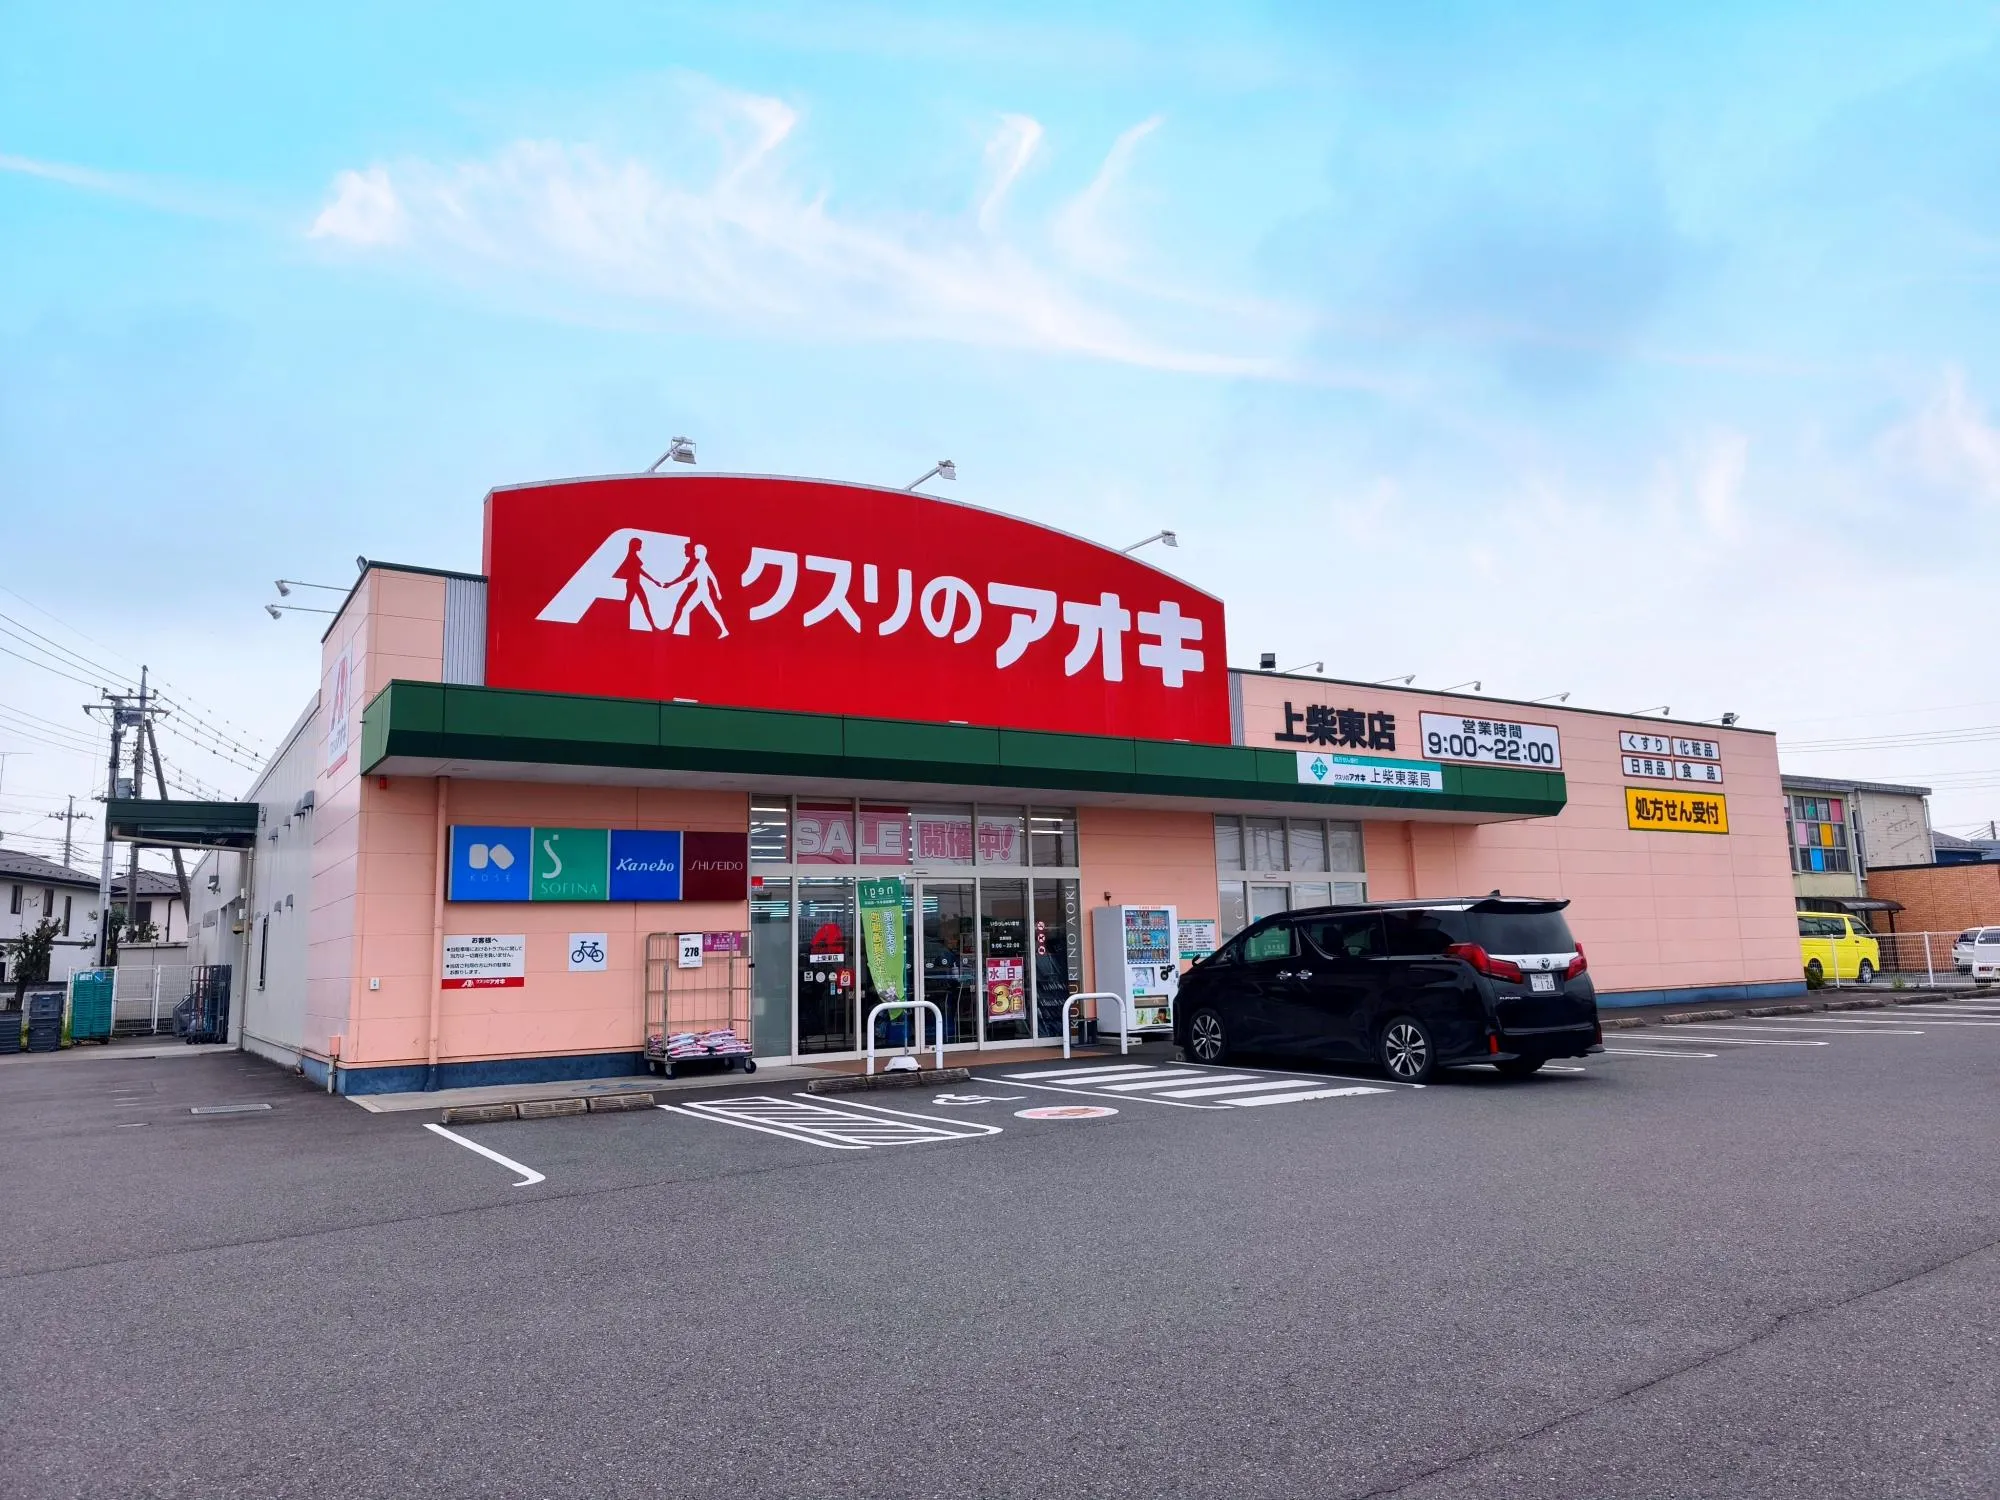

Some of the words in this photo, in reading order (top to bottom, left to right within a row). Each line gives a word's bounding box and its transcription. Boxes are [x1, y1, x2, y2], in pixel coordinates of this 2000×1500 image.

[741, 546, 1205, 688] クスリのアオキ
[1275, 701, 1396, 751] 上柴東店
[1462, 719, 1522, 739] 営業時間
[1628, 735, 1663, 751] くすり
[1680, 740, 1713, 757] 化粧品
[1631, 758, 1666, 776] 日用品
[1370, 767, 1431, 788] 上柴東薬局
[1635, 796, 1719, 825] 処方せん受付
[796, 818, 904, 856] SALE
[616, 857, 675, 873] Kanebo
[687, 860, 744, 871] SHISEIDO
[540, 882, 598, 895] SOFINA
[1065, 886, 1076, 925] AOKI
[684, 947, 700, 957] 278
[1067, 933, 1079, 958] NO
[1068, 966, 1080, 1029] KUURI
